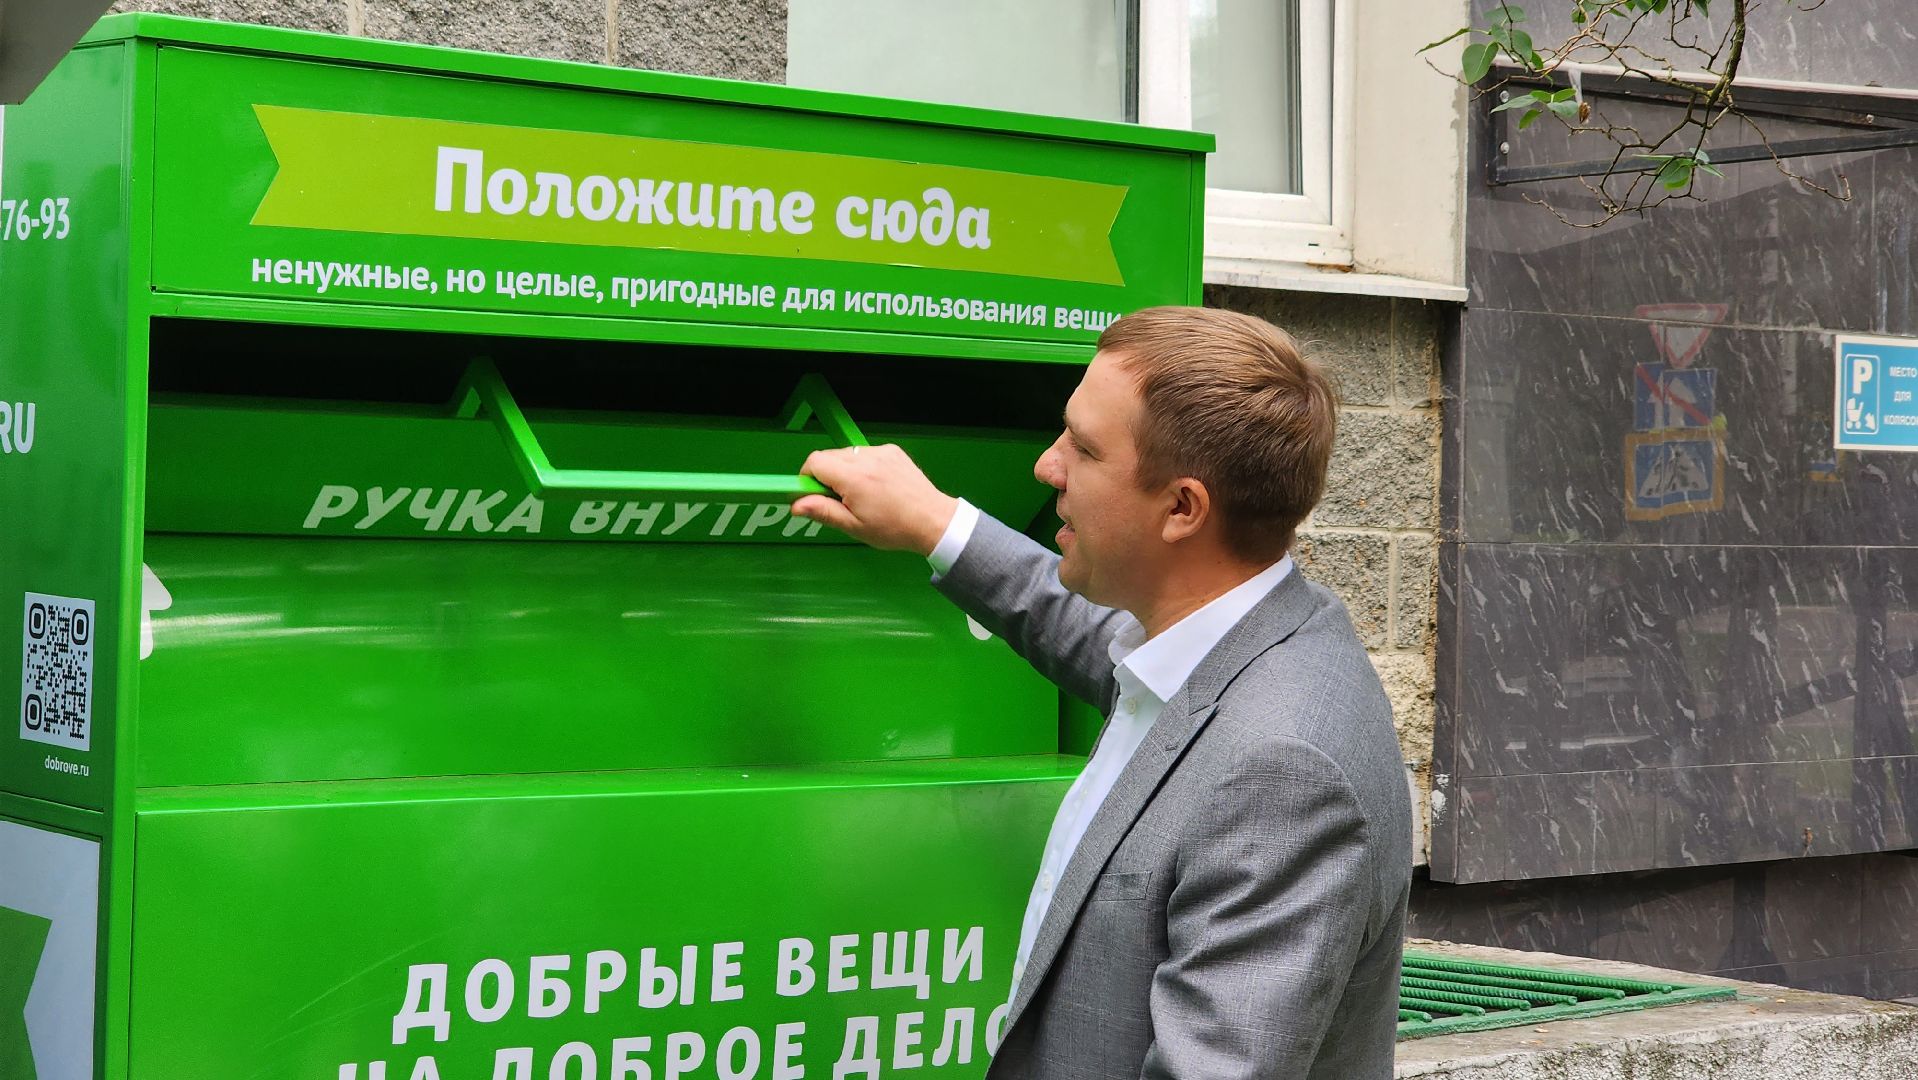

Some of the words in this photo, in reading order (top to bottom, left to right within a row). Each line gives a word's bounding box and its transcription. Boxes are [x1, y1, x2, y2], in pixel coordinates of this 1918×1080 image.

[434, 145, 815, 235] Положите
[835, 187, 991, 250] сюда
[251, 257, 438, 294] ненужные,
[446, 268, 486, 294] но
[496, 269, 604, 302] целые,
[611, 276, 776, 308] пригодные
[782, 286, 835, 313] для
[845, 289, 1047, 327] использования
[1889, 366, 1917, 378] МЕСТО
[1894, 391, 1912, 402] ДЛЯ
[0, 400, 36, 454] RU
[302, 484, 545, 534] РУЧКА
[44, 754, 90, 777] dobrove.ru
[392, 941, 746, 1045] ДОБРЫЕ
[776, 926, 985, 999] ВЕЩИ
